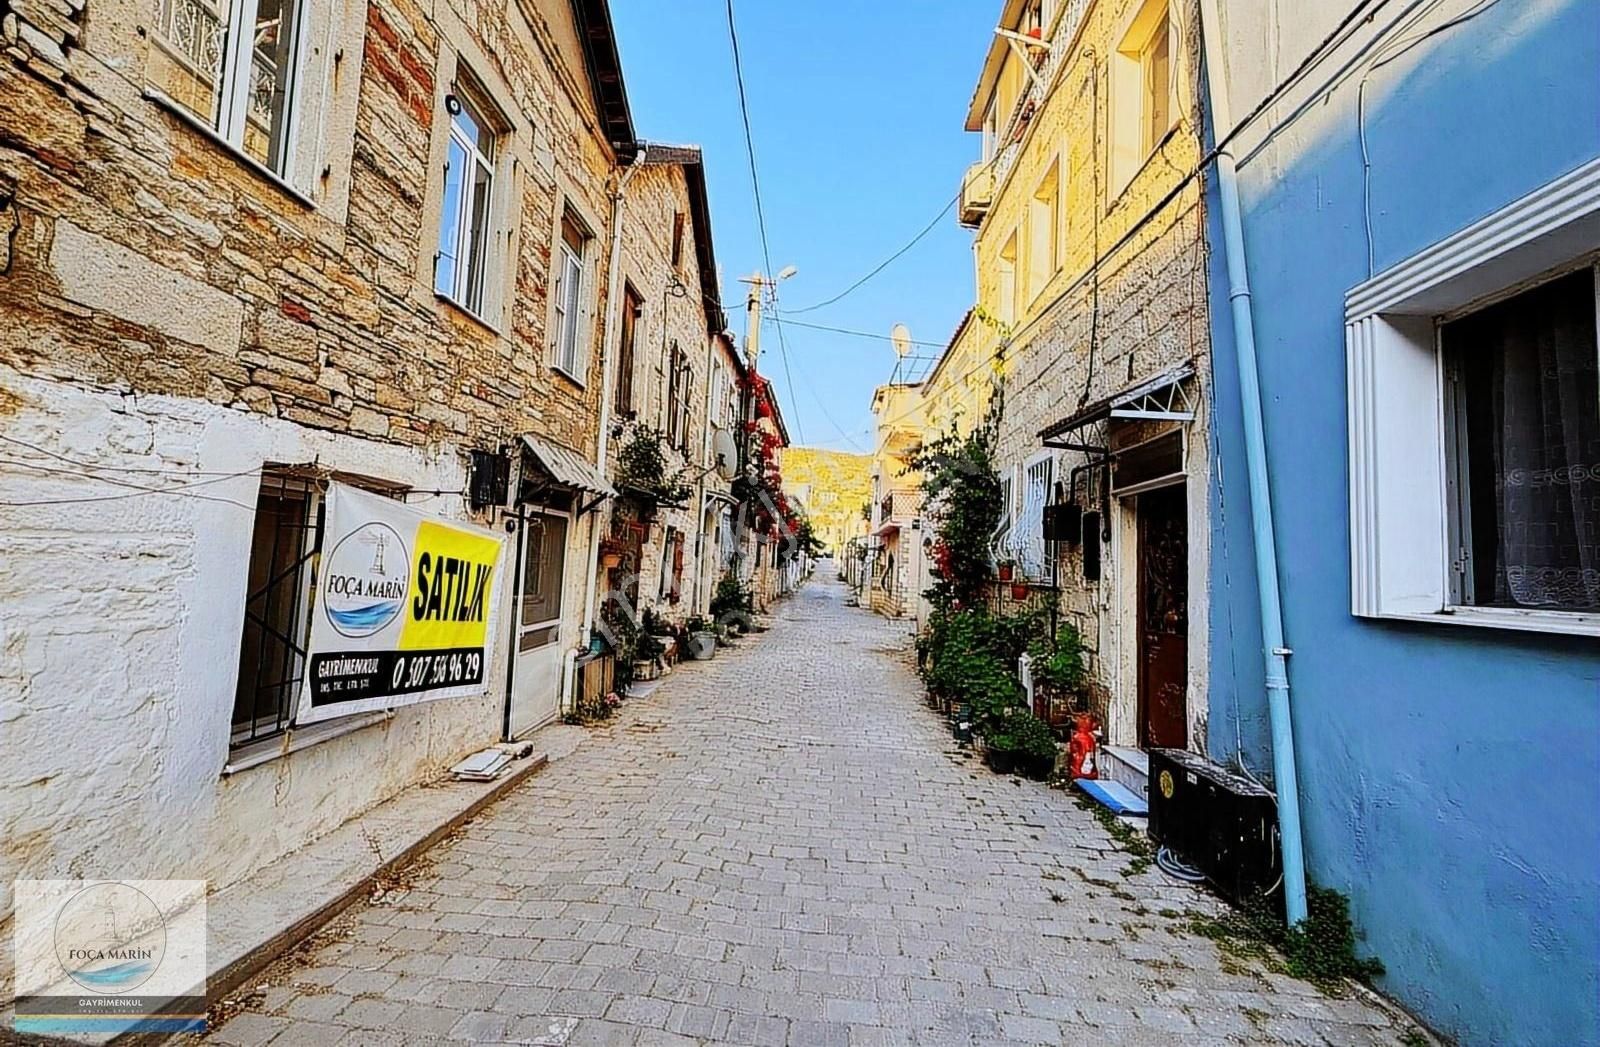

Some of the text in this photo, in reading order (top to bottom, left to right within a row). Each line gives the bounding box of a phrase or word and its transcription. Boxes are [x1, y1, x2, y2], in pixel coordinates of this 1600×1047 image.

[328, 575, 405, 599] FOÇA MARİN
[413, 551, 493, 622] SATILIK
[318, 655, 379, 678] GAYRİMENKUL
[393, 657, 405, 689] 0
[405, 656, 432, 688] 507
[449, 653, 462, 682] 96
[465, 652, 480, 680] 29
